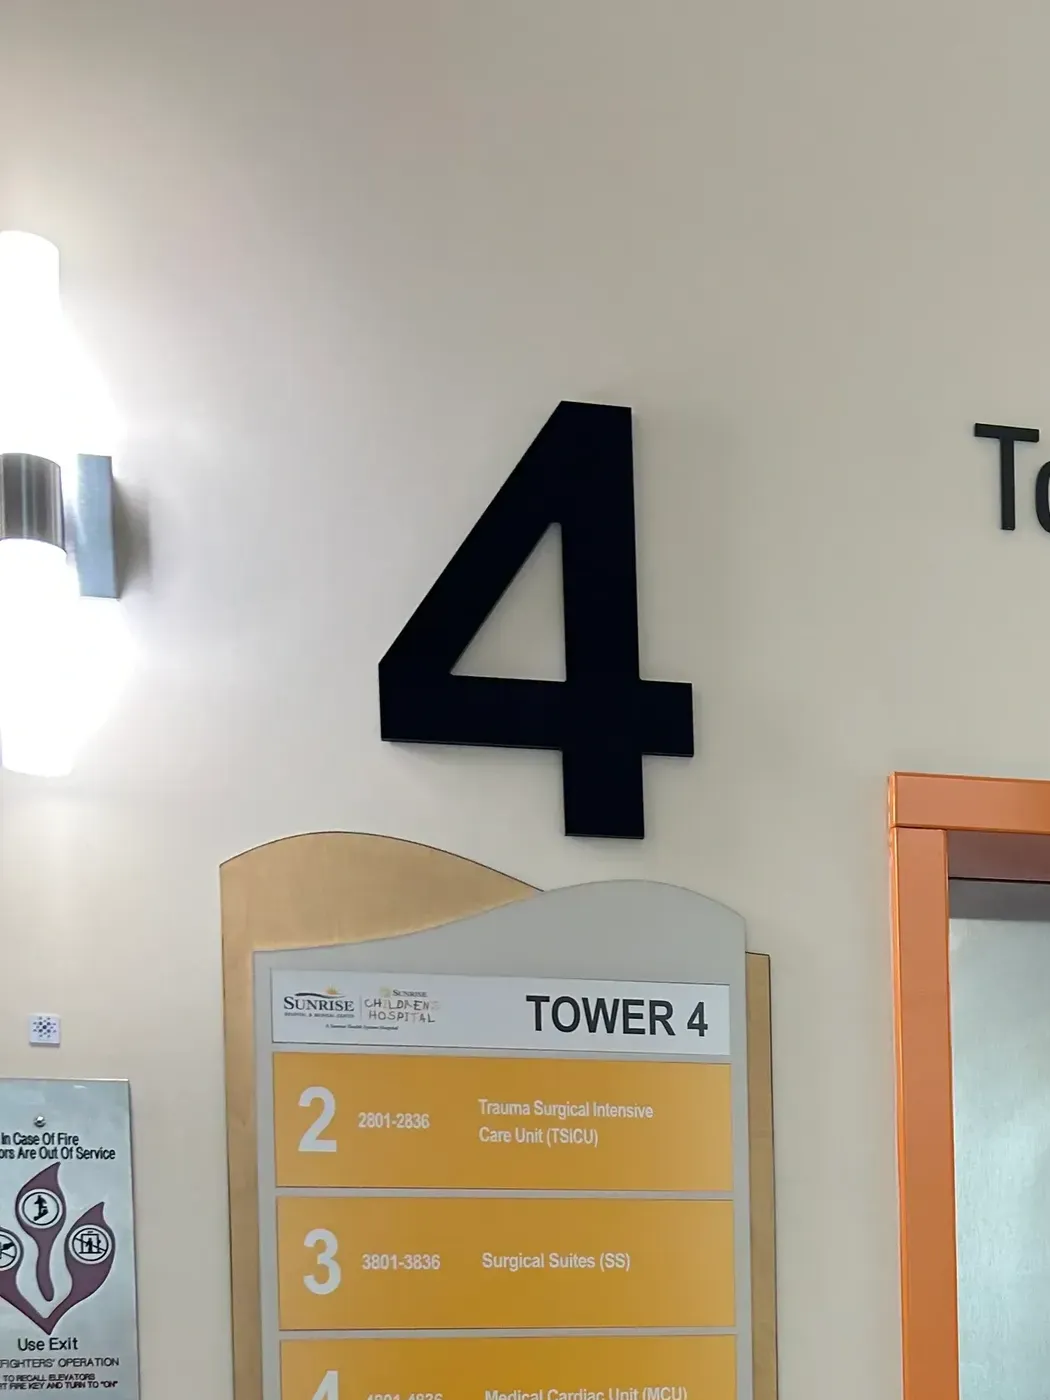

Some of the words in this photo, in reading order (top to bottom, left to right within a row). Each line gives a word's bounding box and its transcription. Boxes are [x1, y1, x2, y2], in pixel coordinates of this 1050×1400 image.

[378, 400, 694, 840] 4
[283, 995, 355, 1012] SUNRISE
[368, 1010, 436, 1023] HOSPITAL
[526, 994, 676, 1036] TOWER
[687, 1001, 709, 1037] 4
[478, 1098, 531, 1117] Trauma
[533, 1100, 590, 1120] Surgical
[593, 1102, 654, 1119] Intensive
[298, 1086, 337, 1152] 2
[358, 1112, 430, 1129] 2801-2836
[1, 1132, 11, 1145] In
[13, 1132, 40, 1146] Case
[42, 1132, 56, 1145] Of
[57, 1132, 79, 1145] Fire
[478, 1127, 511, 1144] Care
[515, 1128, 543, 1144] Unit
[547, 1128, 598, 1147] (TSICU)
[17, 1147, 37, 1160] Are
[39, 1147, 59, 1159] Out
[60, 1147, 74, 1159] Of
[75, 1146, 116, 1160] Service
[303, 1228, 342, 1295] 3
[362, 1253, 441, 1271] 3801-3836
[482, 1252, 545, 1272] Surgical
[548, 1252, 596, 1269] Suites
[599, 1253, 631, 1272] (SS)
[18, 1338, 45, 1351] Use
[50, 1337, 78, 1350] Exit
[58, 1357, 120, 1368] OPERATION
[16, 1374, 47, 1382] RECALL
[49, 1373, 95, 1381] ELEVATORS
